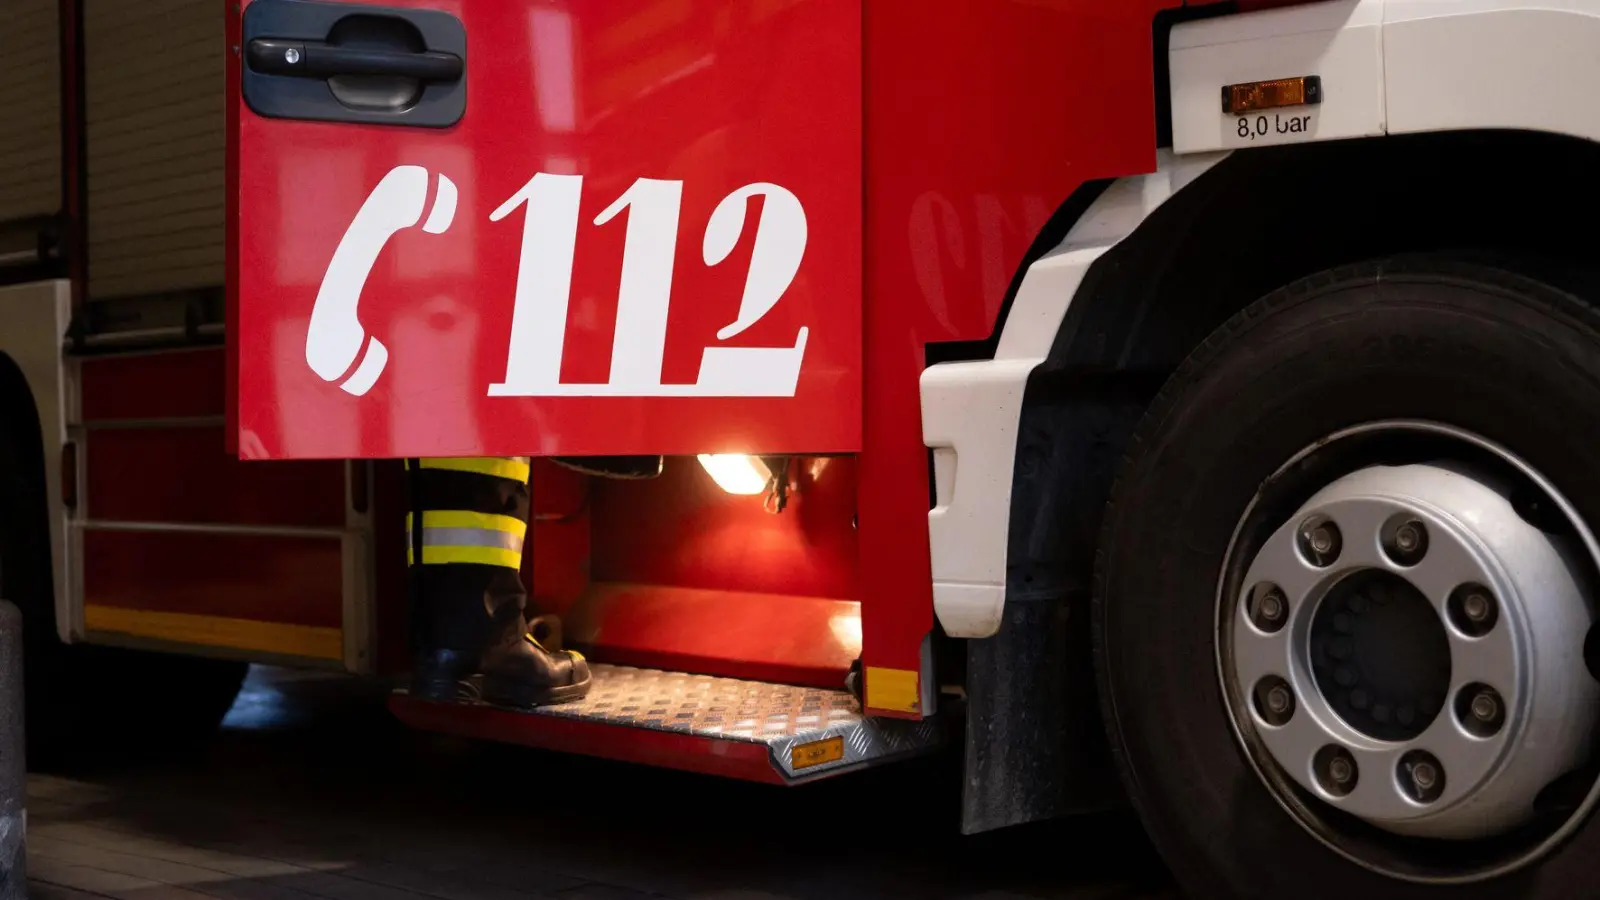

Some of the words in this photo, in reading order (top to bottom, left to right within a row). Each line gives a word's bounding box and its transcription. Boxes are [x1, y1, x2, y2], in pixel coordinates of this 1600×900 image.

[1237, 115, 1268, 140] 8,0
[1275, 114, 1311, 134] bar
[487, 172, 809, 397] 112
